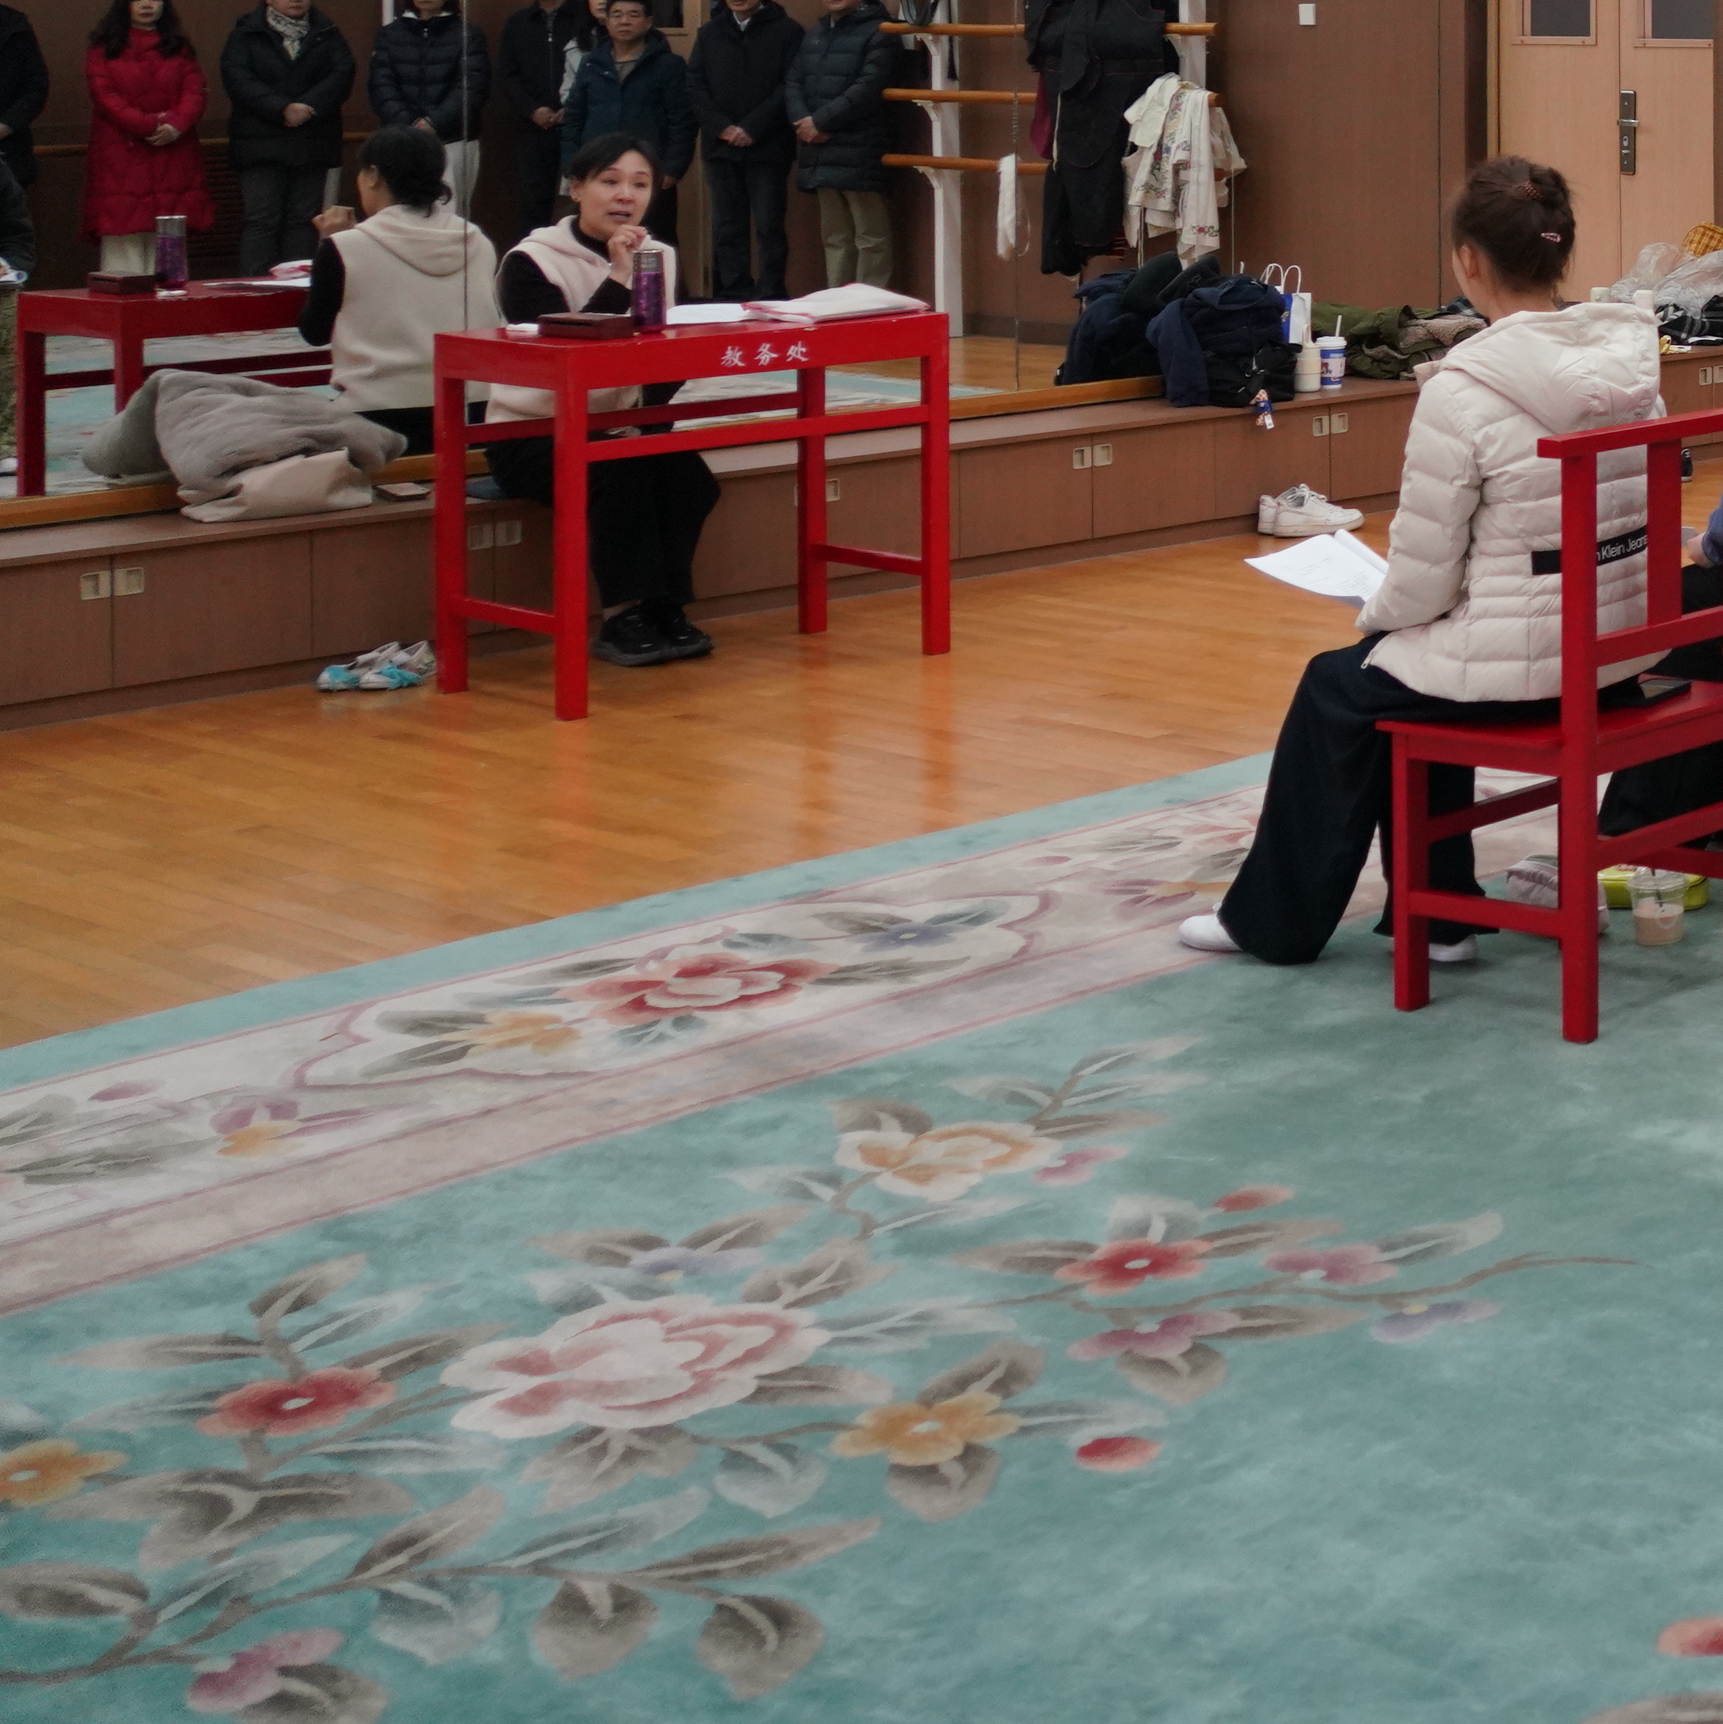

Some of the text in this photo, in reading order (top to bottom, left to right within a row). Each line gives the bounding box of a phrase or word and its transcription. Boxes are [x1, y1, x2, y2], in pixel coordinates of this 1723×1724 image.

[721, 341, 809, 367] 教务处
[1601, 542, 1625, 560] Klein
